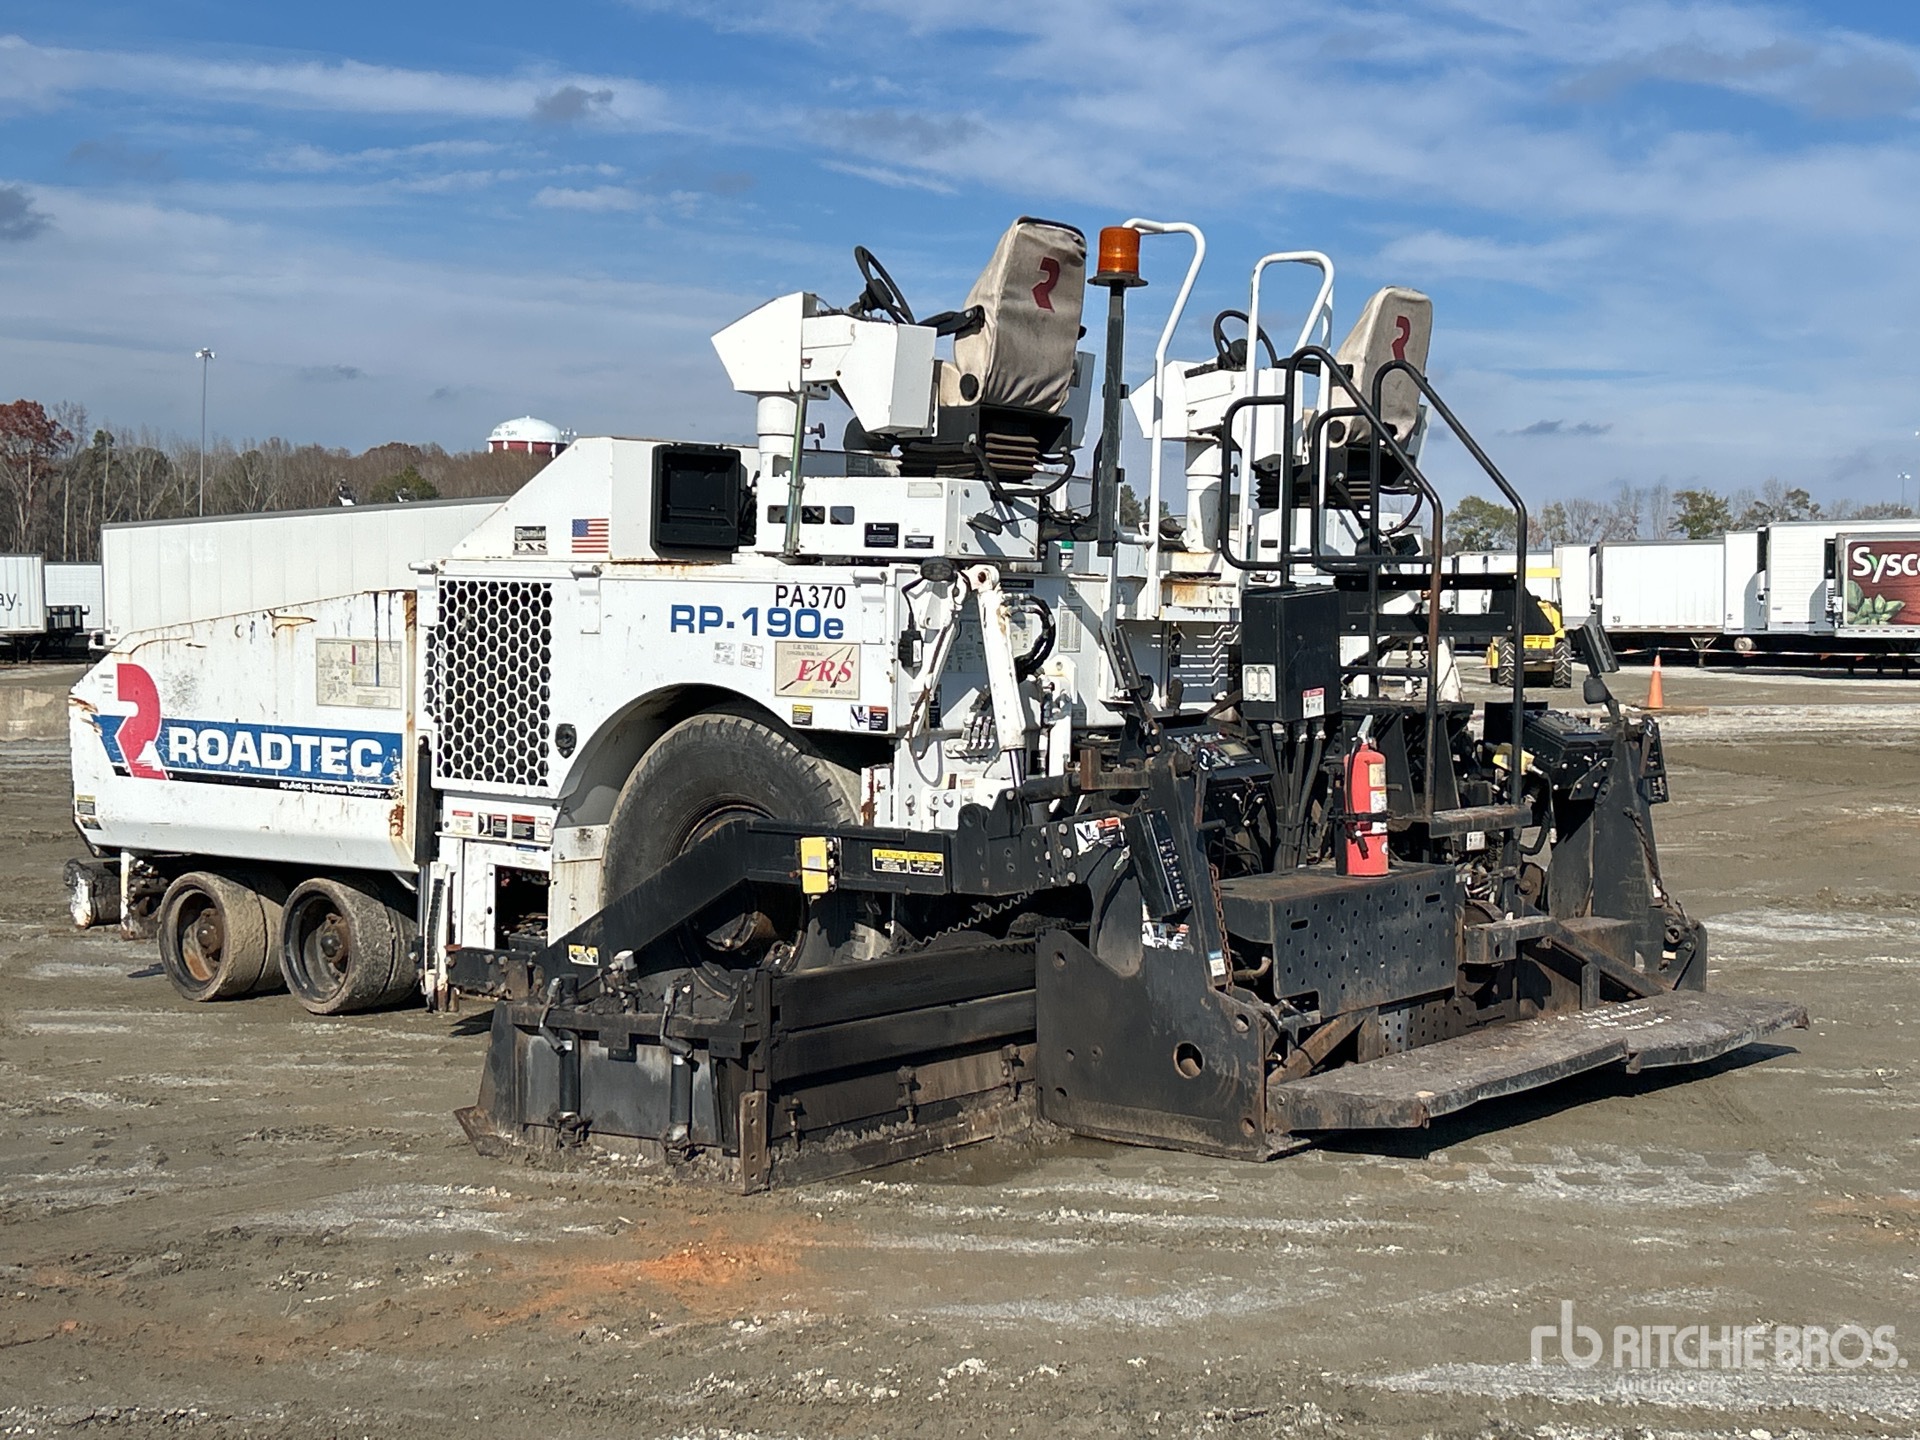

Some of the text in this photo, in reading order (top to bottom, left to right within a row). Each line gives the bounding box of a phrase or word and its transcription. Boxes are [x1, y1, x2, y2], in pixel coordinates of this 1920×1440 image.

[1852, 546, 1920, 583] Sysc
[775, 585, 846, 609] PA370
[671, 604, 844, 639] RP-190e
[796, 659, 855, 683] ERS
[168, 726, 383, 777] ROADTEC
